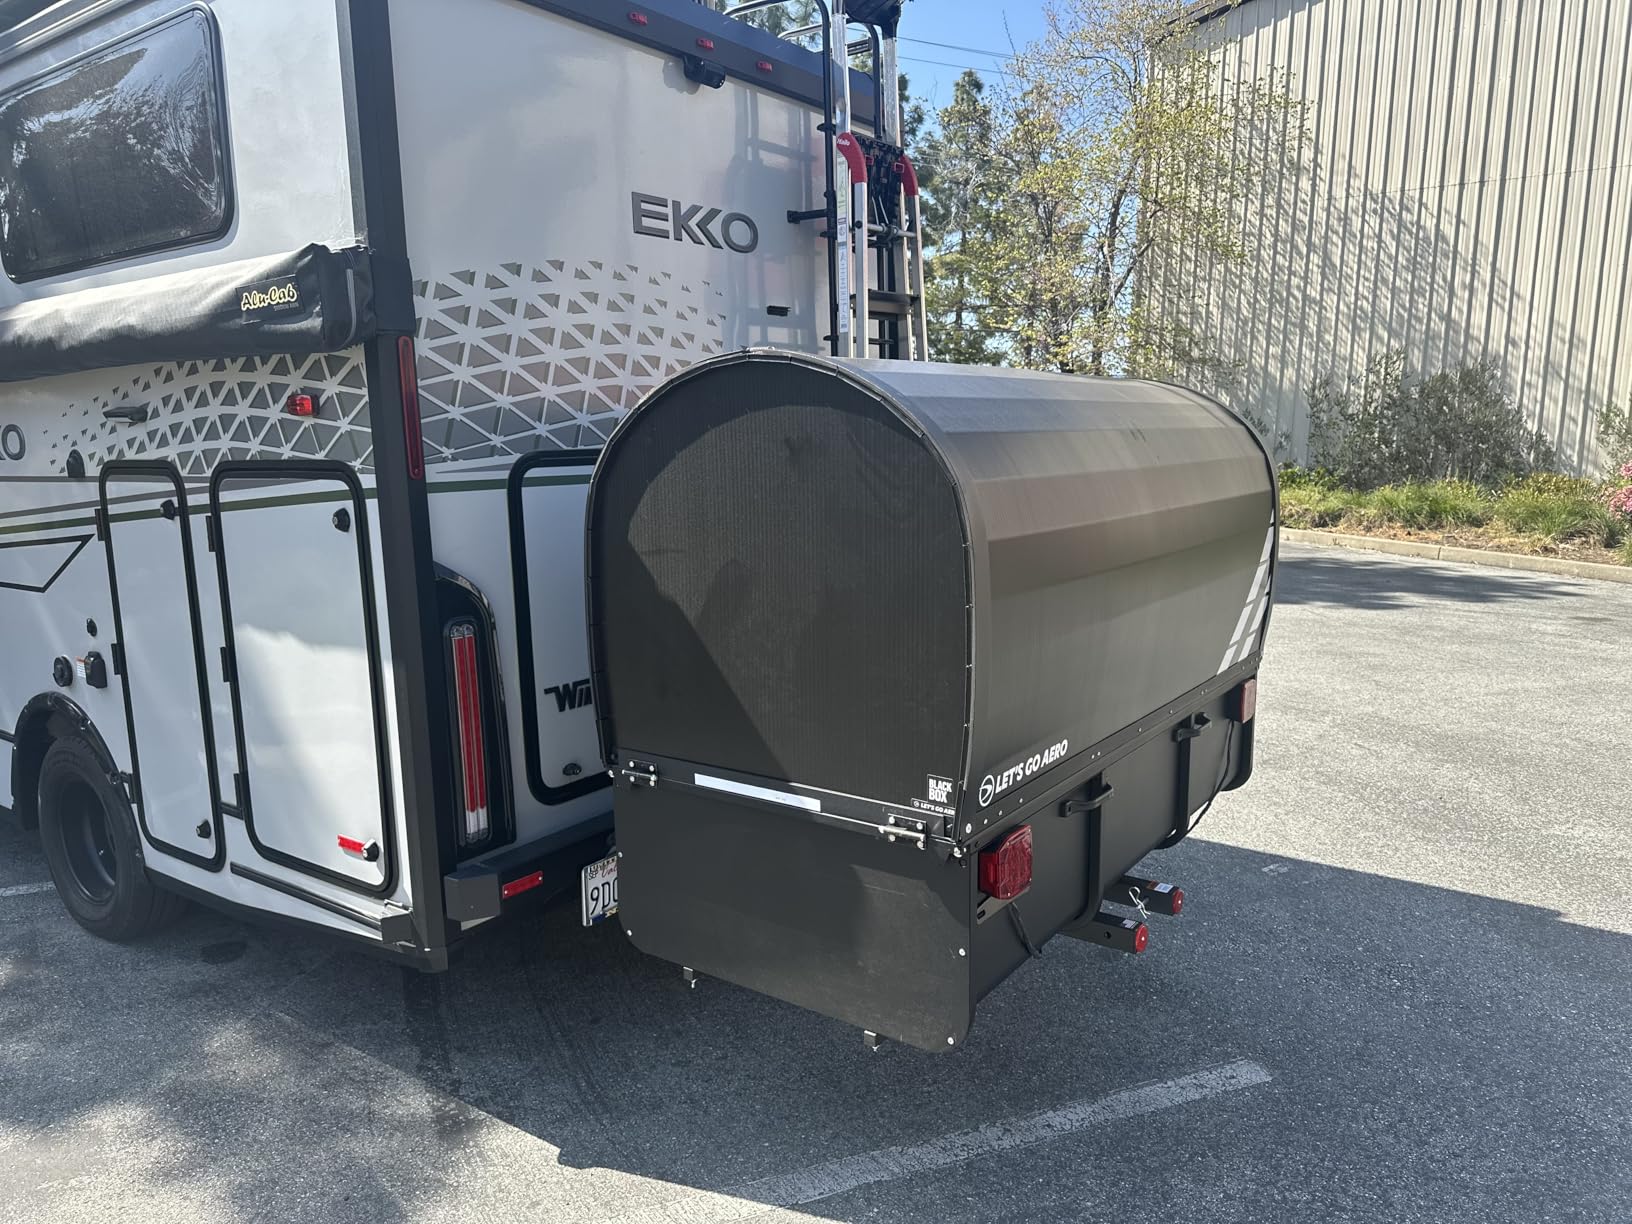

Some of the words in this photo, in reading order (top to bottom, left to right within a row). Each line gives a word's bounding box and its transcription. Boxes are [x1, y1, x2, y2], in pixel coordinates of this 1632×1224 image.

[631, 191, 759, 254] EKKO
[995, 762, 1024, 794] LET'S
[1025, 753, 1041, 776] GO
[1040, 739, 1068, 768] AERO
[928, 778, 953, 793] BLACK
[928, 788, 948, 803] BOX
